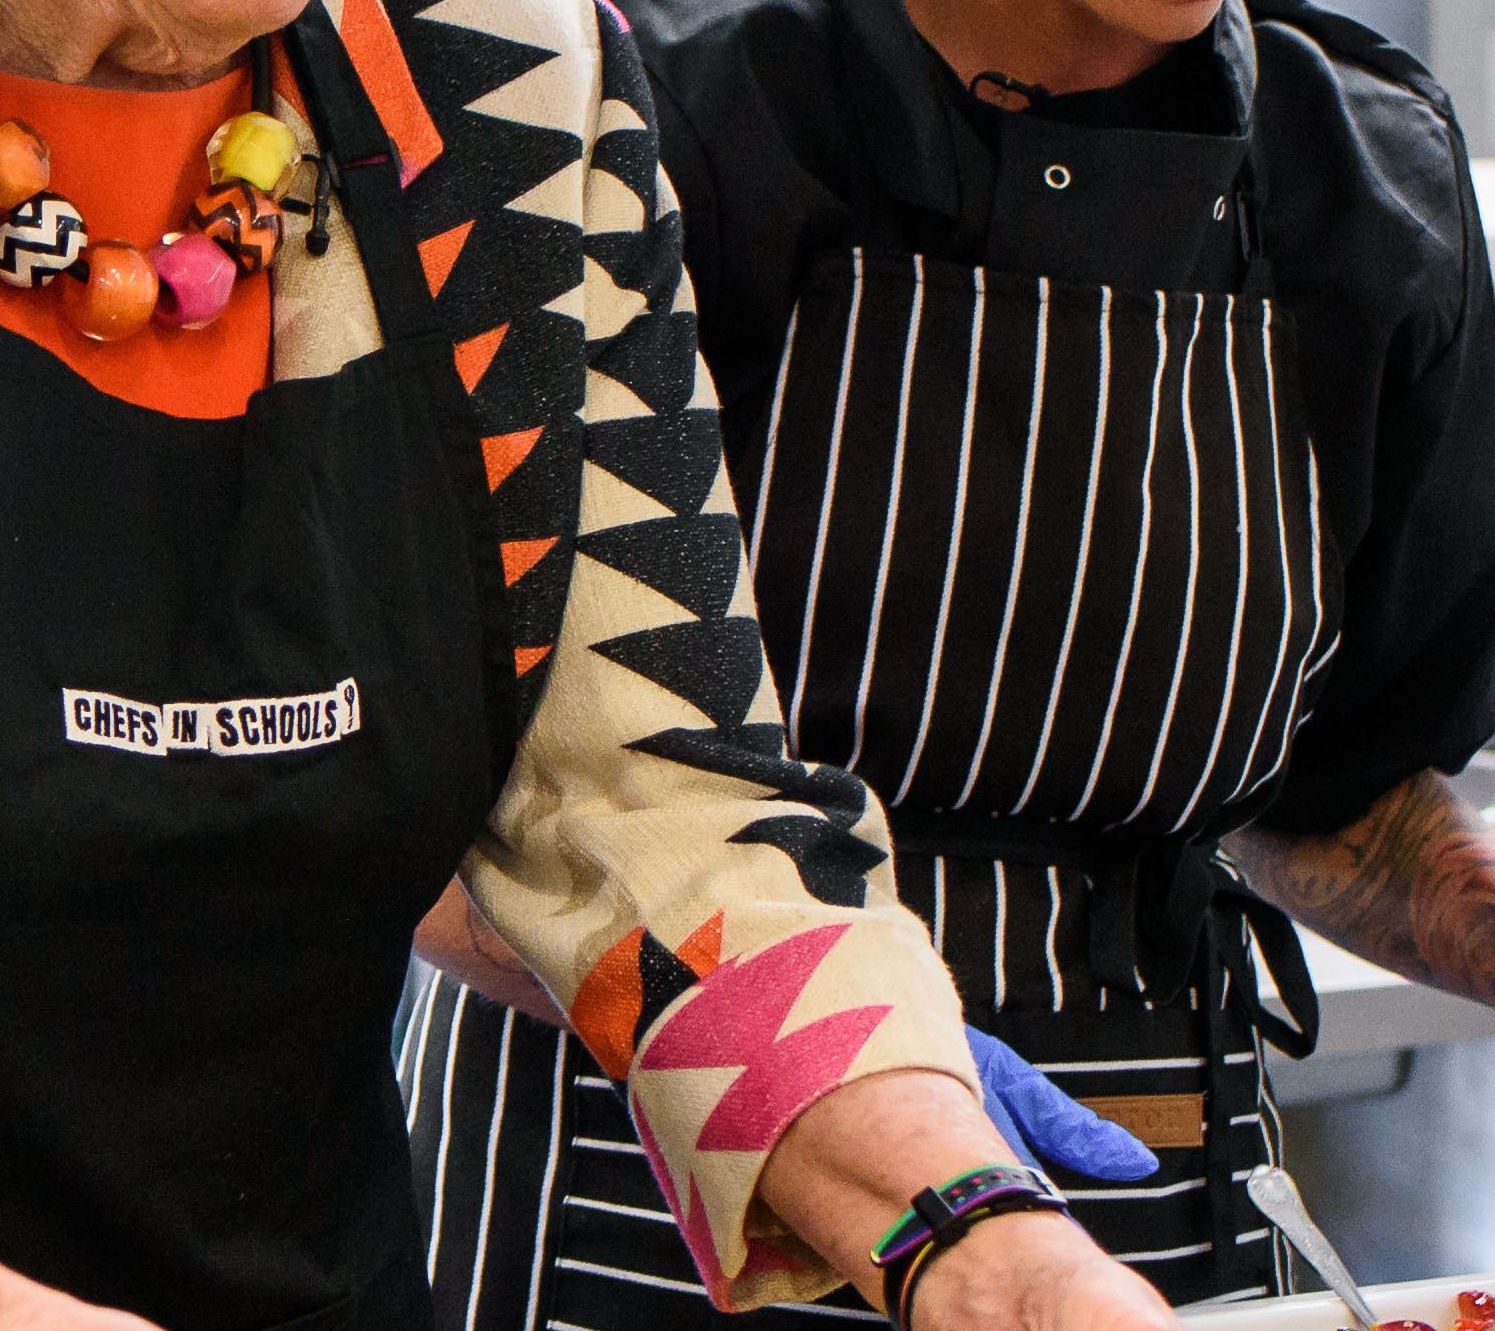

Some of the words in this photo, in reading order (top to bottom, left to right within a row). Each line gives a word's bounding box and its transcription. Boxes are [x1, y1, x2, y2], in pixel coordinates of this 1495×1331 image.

[73, 696, 159, 747] CHEFS
[172, 709, 199, 743] IN
[215, 699, 338, 747] SCHOOLS
